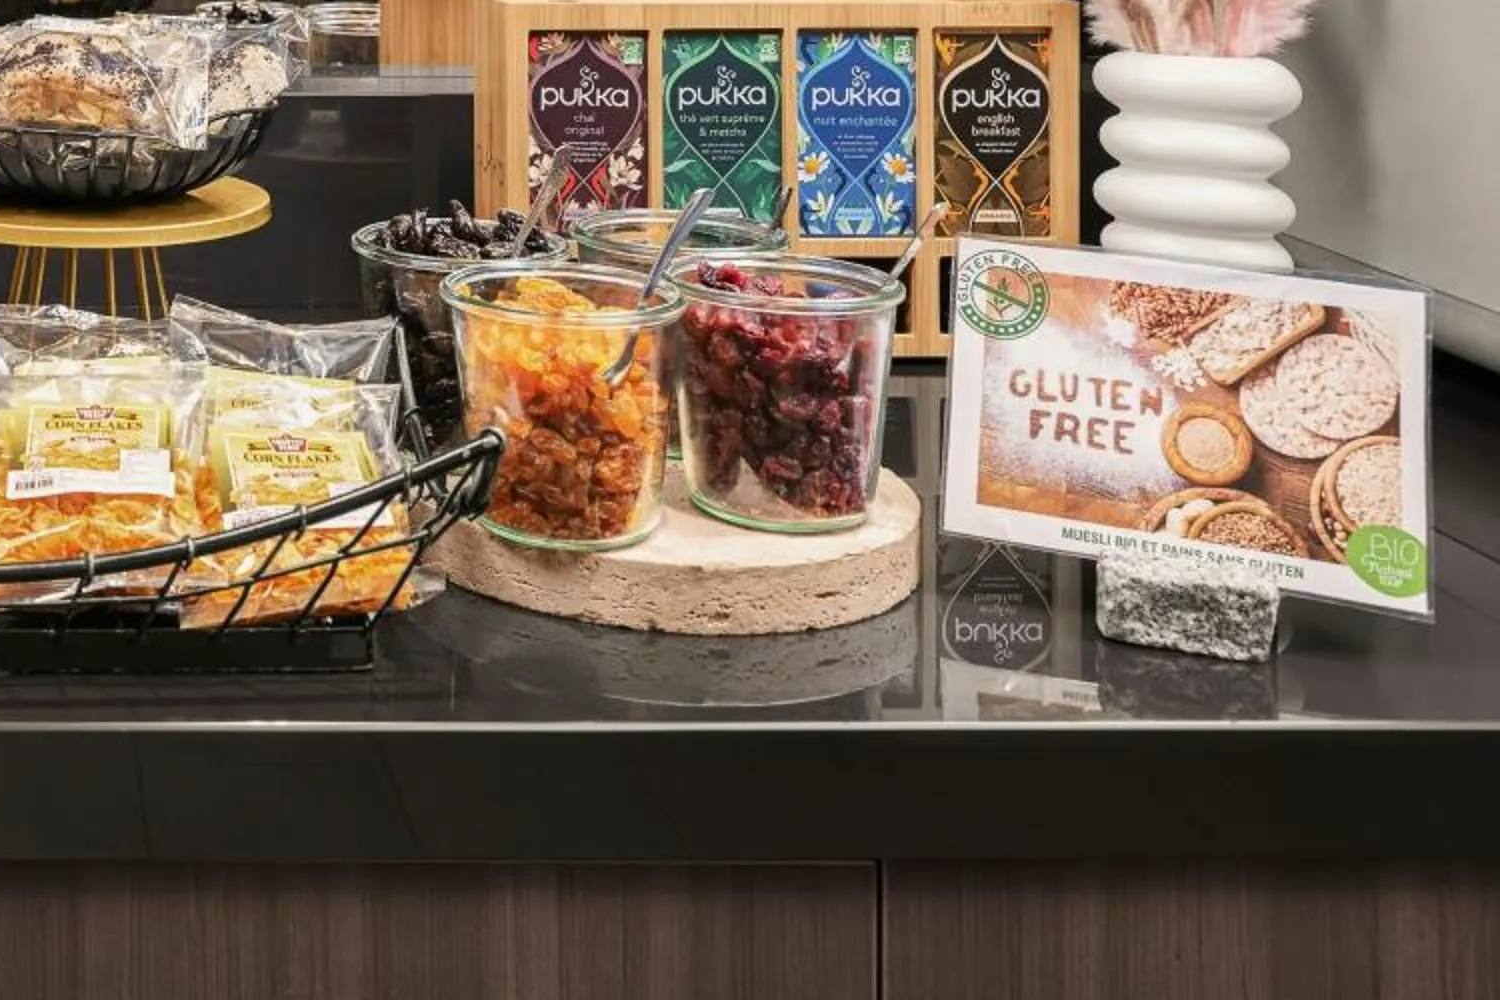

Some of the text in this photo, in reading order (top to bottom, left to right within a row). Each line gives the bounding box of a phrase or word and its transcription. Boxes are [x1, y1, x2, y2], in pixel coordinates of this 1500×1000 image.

[540, 86, 629, 111] pukka
[678, 86, 767, 111] pukka
[811, 86, 900, 111] pukka
[951, 87, 1041, 113] pukka
[573, 113, 596, 123] chai
[813, 114, 898, 127] nuit enchantée
[977, 113, 1015, 128] english
[564, 125, 605, 137] original
[709, 127, 747, 137] matcha
[971, 125, 1021, 137] breakfast
[957, 254, 1039, 302] GLUTEN FREE
[1008, 368, 1164, 417] GLUTEN
[44, 421, 144, 431] CORN FLAKES
[1028, 408, 1137, 456] FREE
[243, 452, 343, 464] CORN FLAKES
[1061, 527, 1112, 546] MUESLI
[1141, 539, 1158, 553] ET
[1370, 533, 1419, 566] BIO
